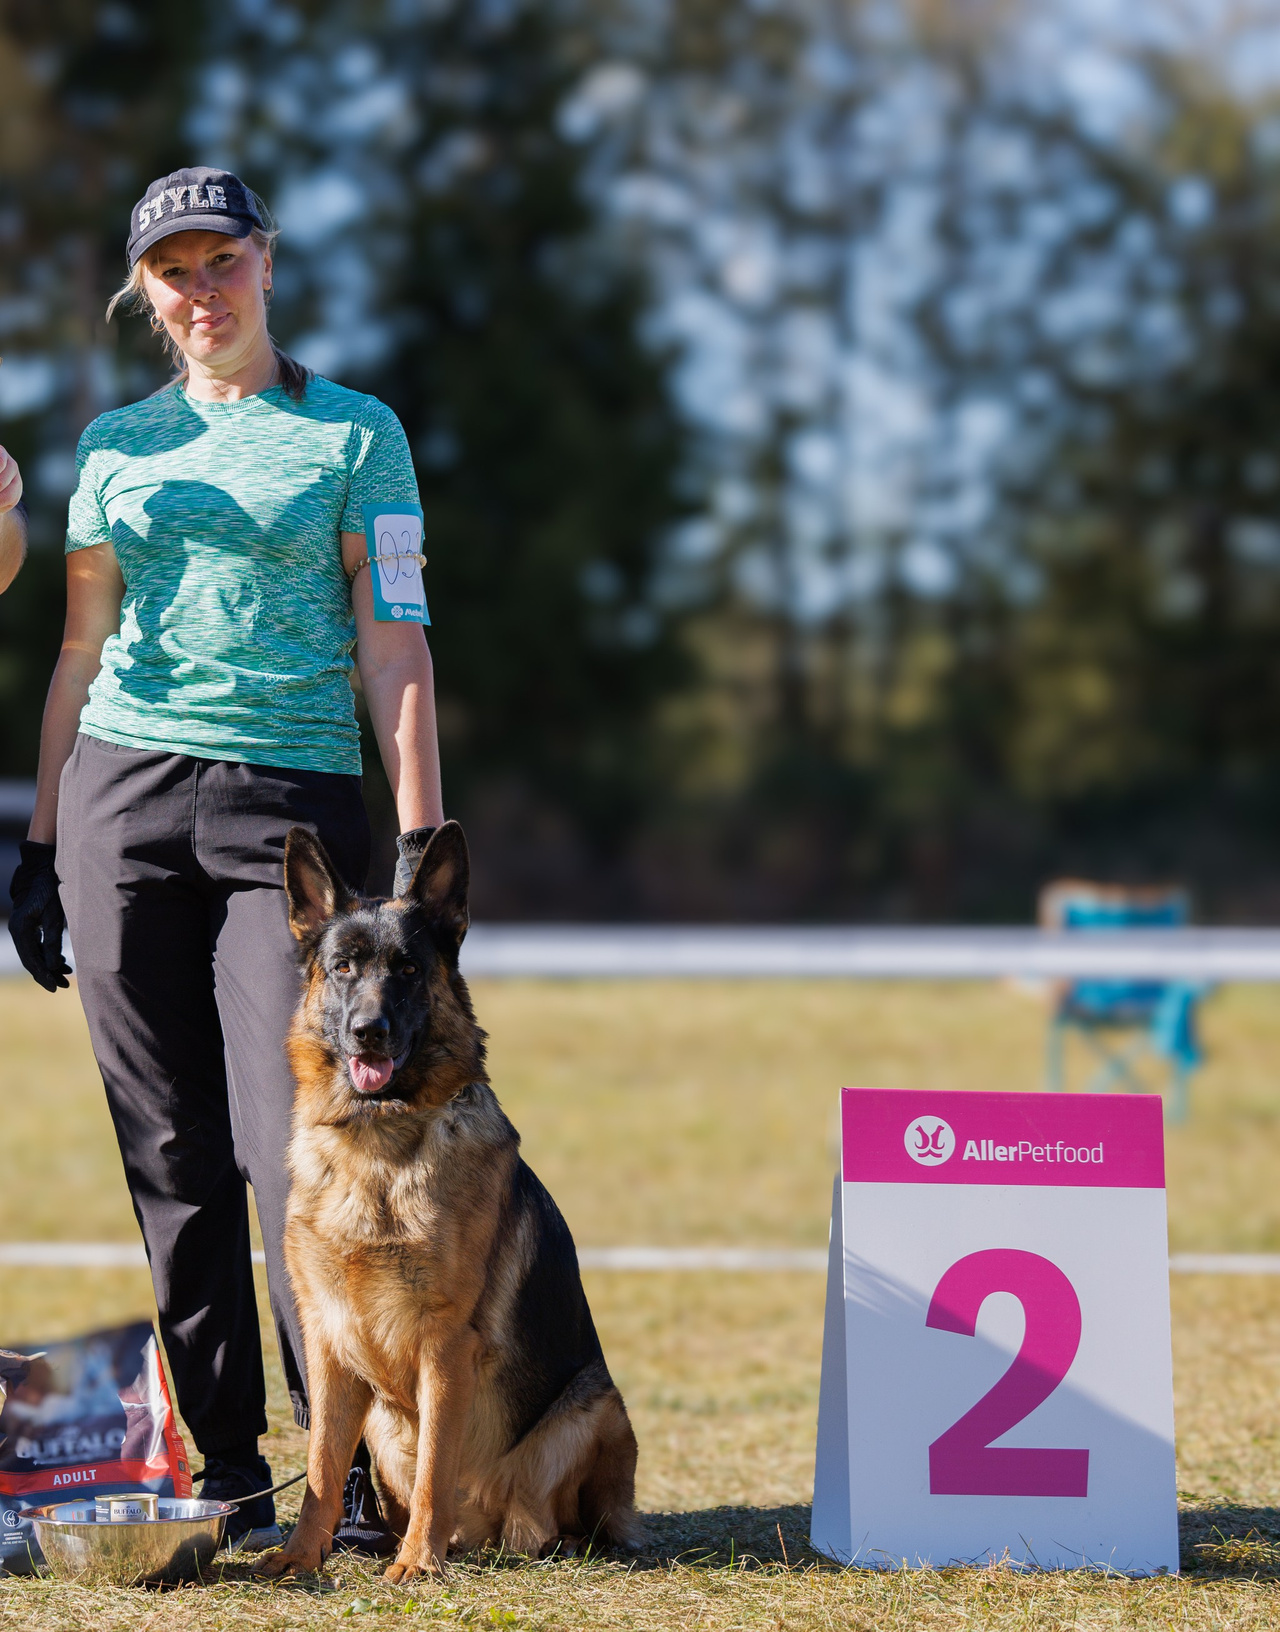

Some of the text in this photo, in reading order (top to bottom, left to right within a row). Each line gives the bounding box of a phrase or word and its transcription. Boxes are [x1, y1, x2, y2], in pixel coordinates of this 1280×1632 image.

[138, 184, 228, 232] STYLE
[962, 1139, 1104, 1163] AllerPetfood
[925, 1248, 1089, 1497] 2
[53, 1469, 97, 1486] ADULT
